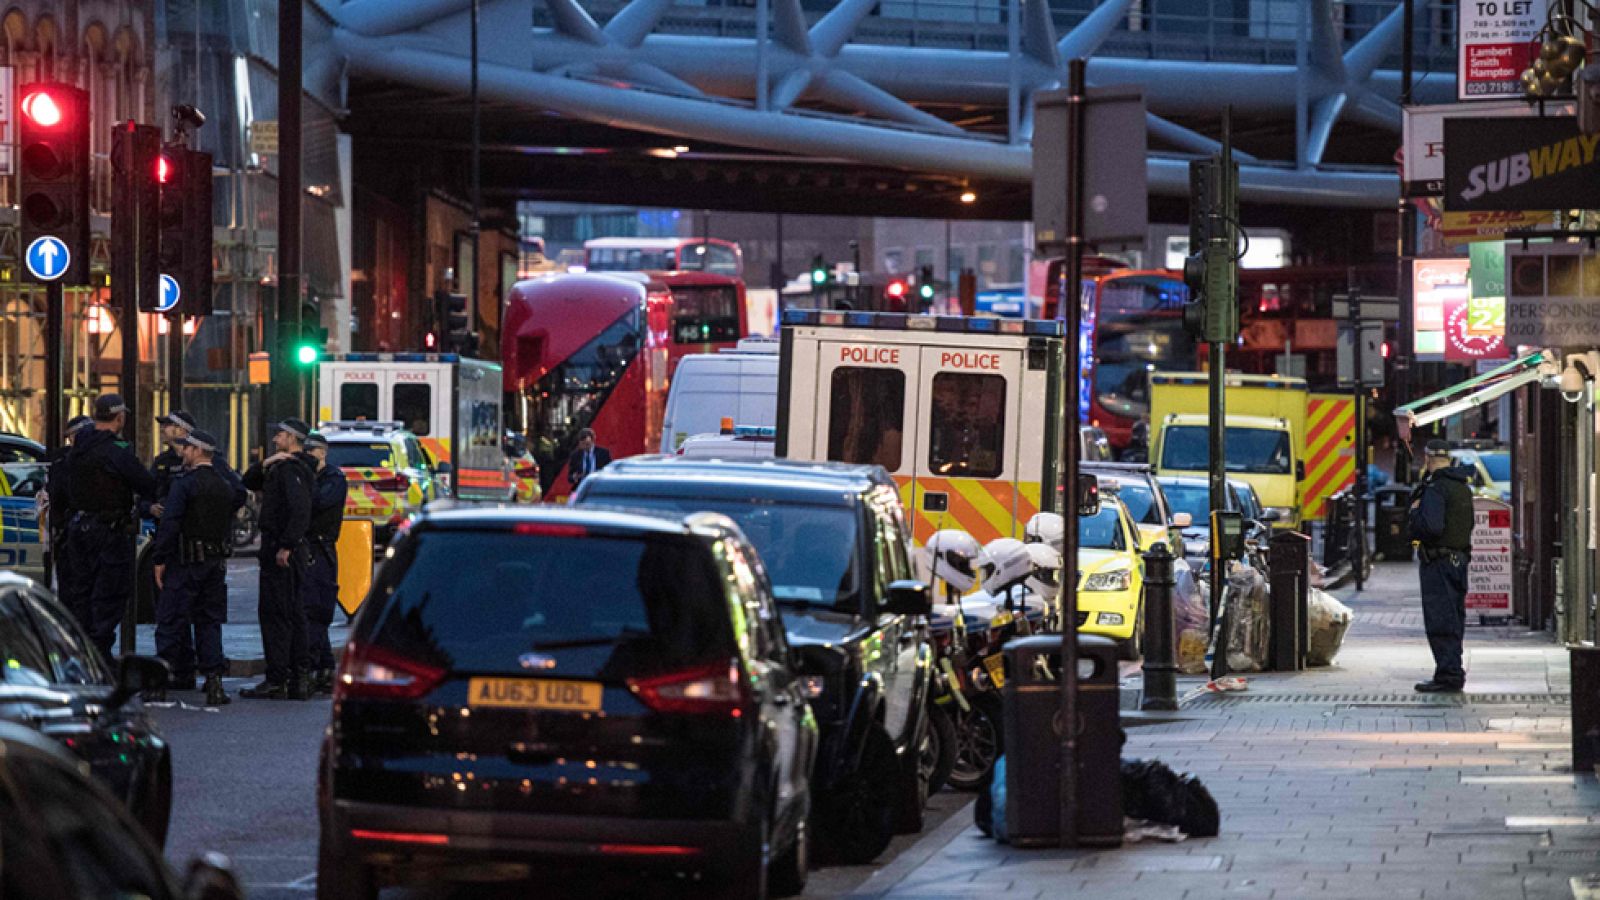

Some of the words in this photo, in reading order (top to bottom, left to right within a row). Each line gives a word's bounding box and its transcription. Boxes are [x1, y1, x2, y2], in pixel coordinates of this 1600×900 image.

[1476, 2, 1498, 16] TO
[1504, 1, 1533, 15] LET
[1470, 46, 1513, 57] Lambert
[1470, 57, 1499, 67] Smith
[1470, 68, 1516, 79] Hampton
[1467, 82, 1487, 93] 020
[1460, 132, 1600, 200] SUBWAY
[840, 347, 899, 364] POLICE
[941, 352, 1000, 369] POLICE
[344, 371, 376, 380] POLICE
[396, 371, 427, 380] POLICE
[479, 681, 540, 702] AU63
[546, 683, 591, 705] UDL
